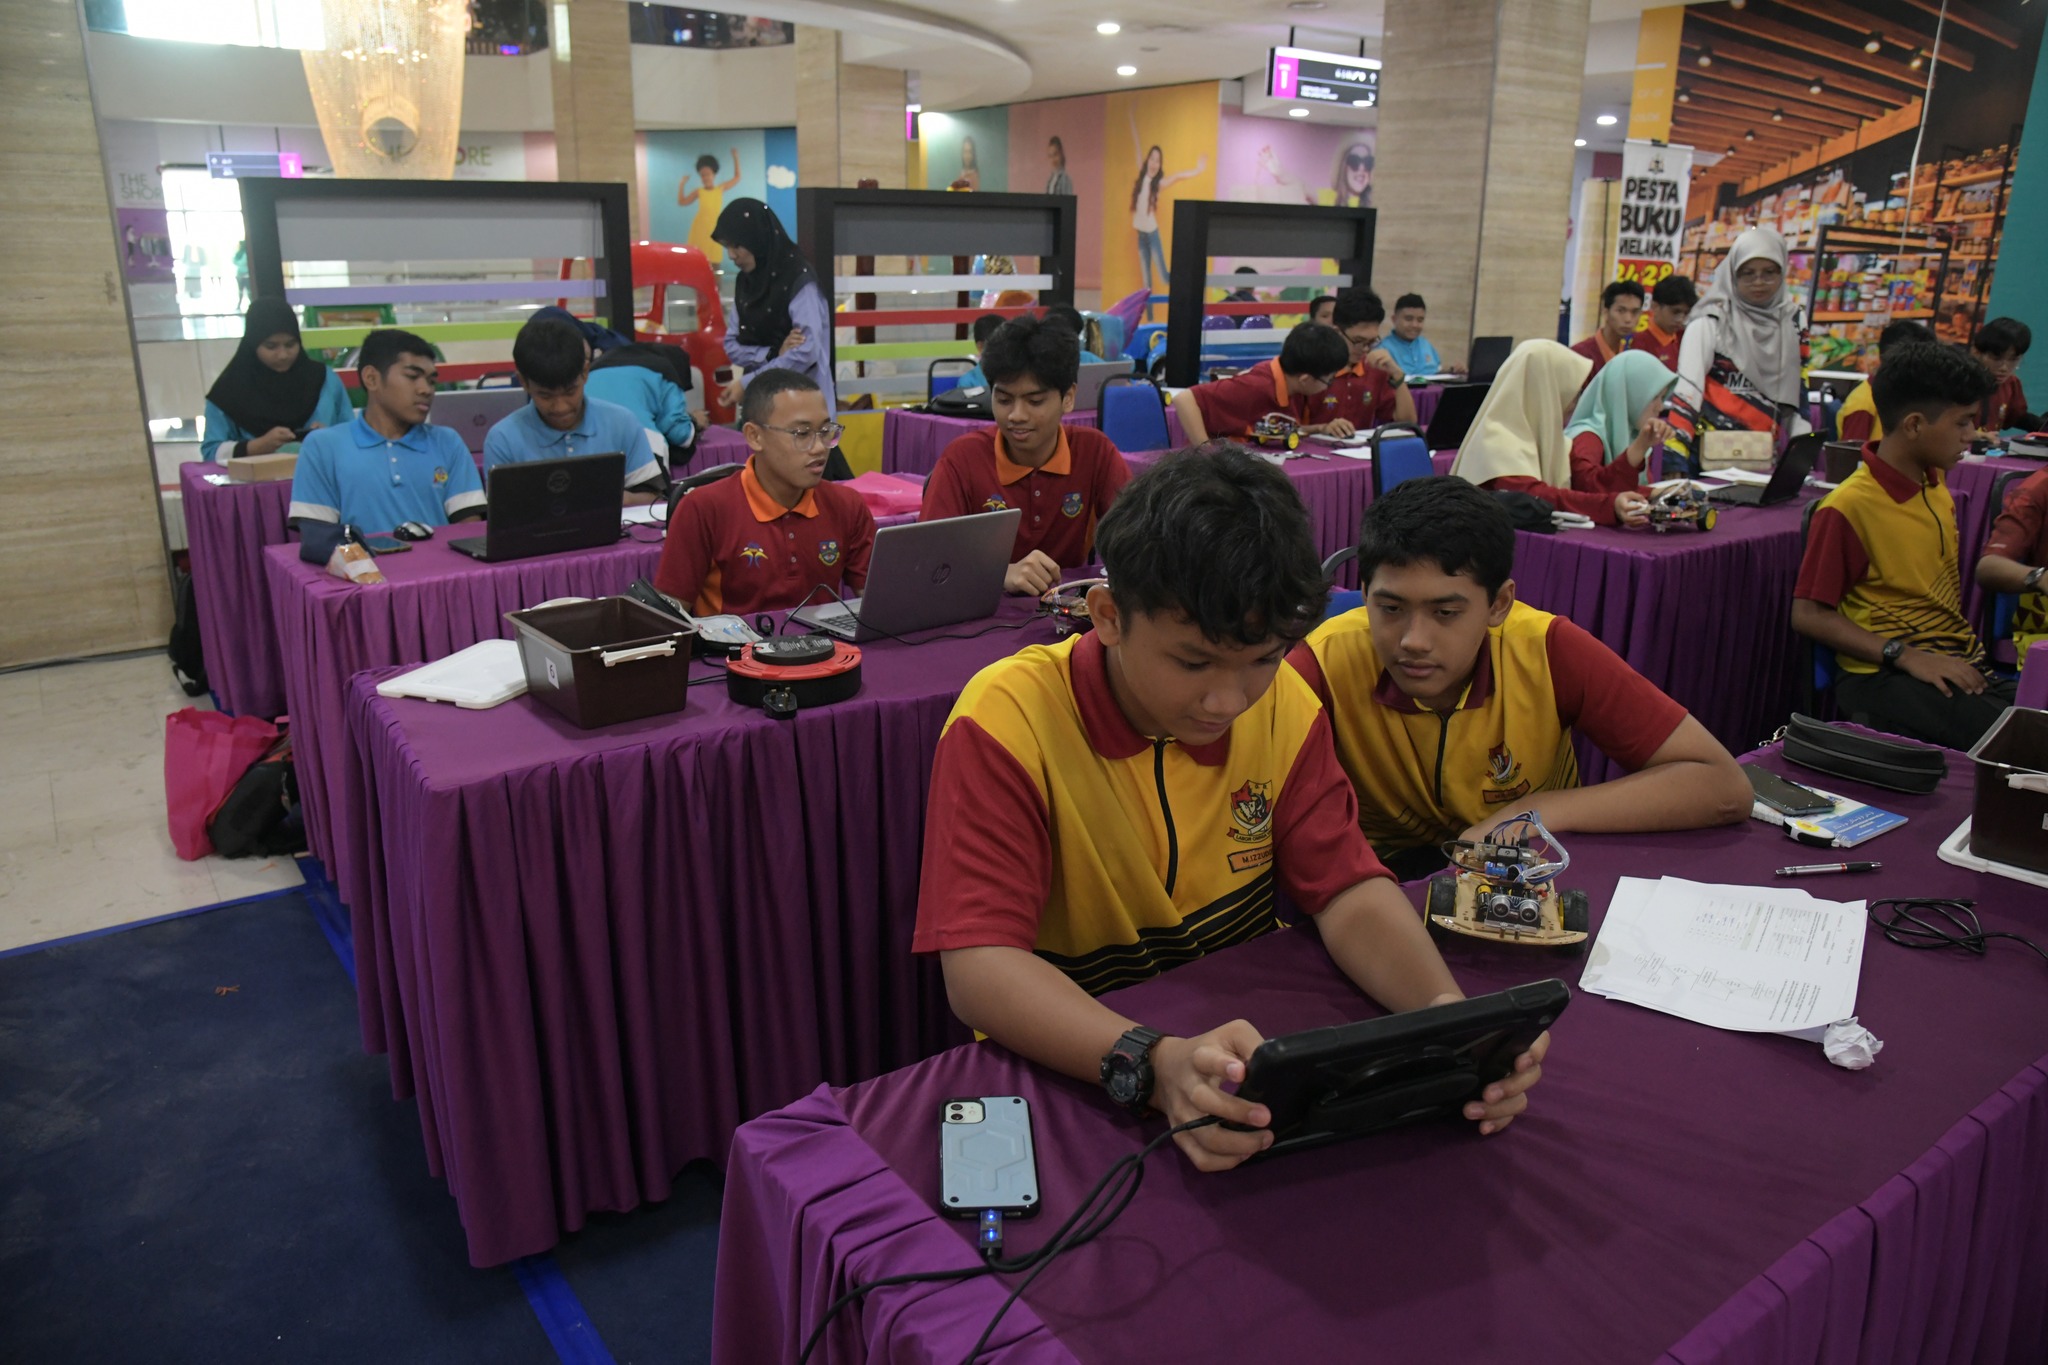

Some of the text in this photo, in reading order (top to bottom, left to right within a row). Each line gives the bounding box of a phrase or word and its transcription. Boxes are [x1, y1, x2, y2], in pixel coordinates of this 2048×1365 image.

[118, 172, 148, 185] THE
[1625, 177, 1679, 204] PESTA
[1620, 204, 1681, 236] BUKU
